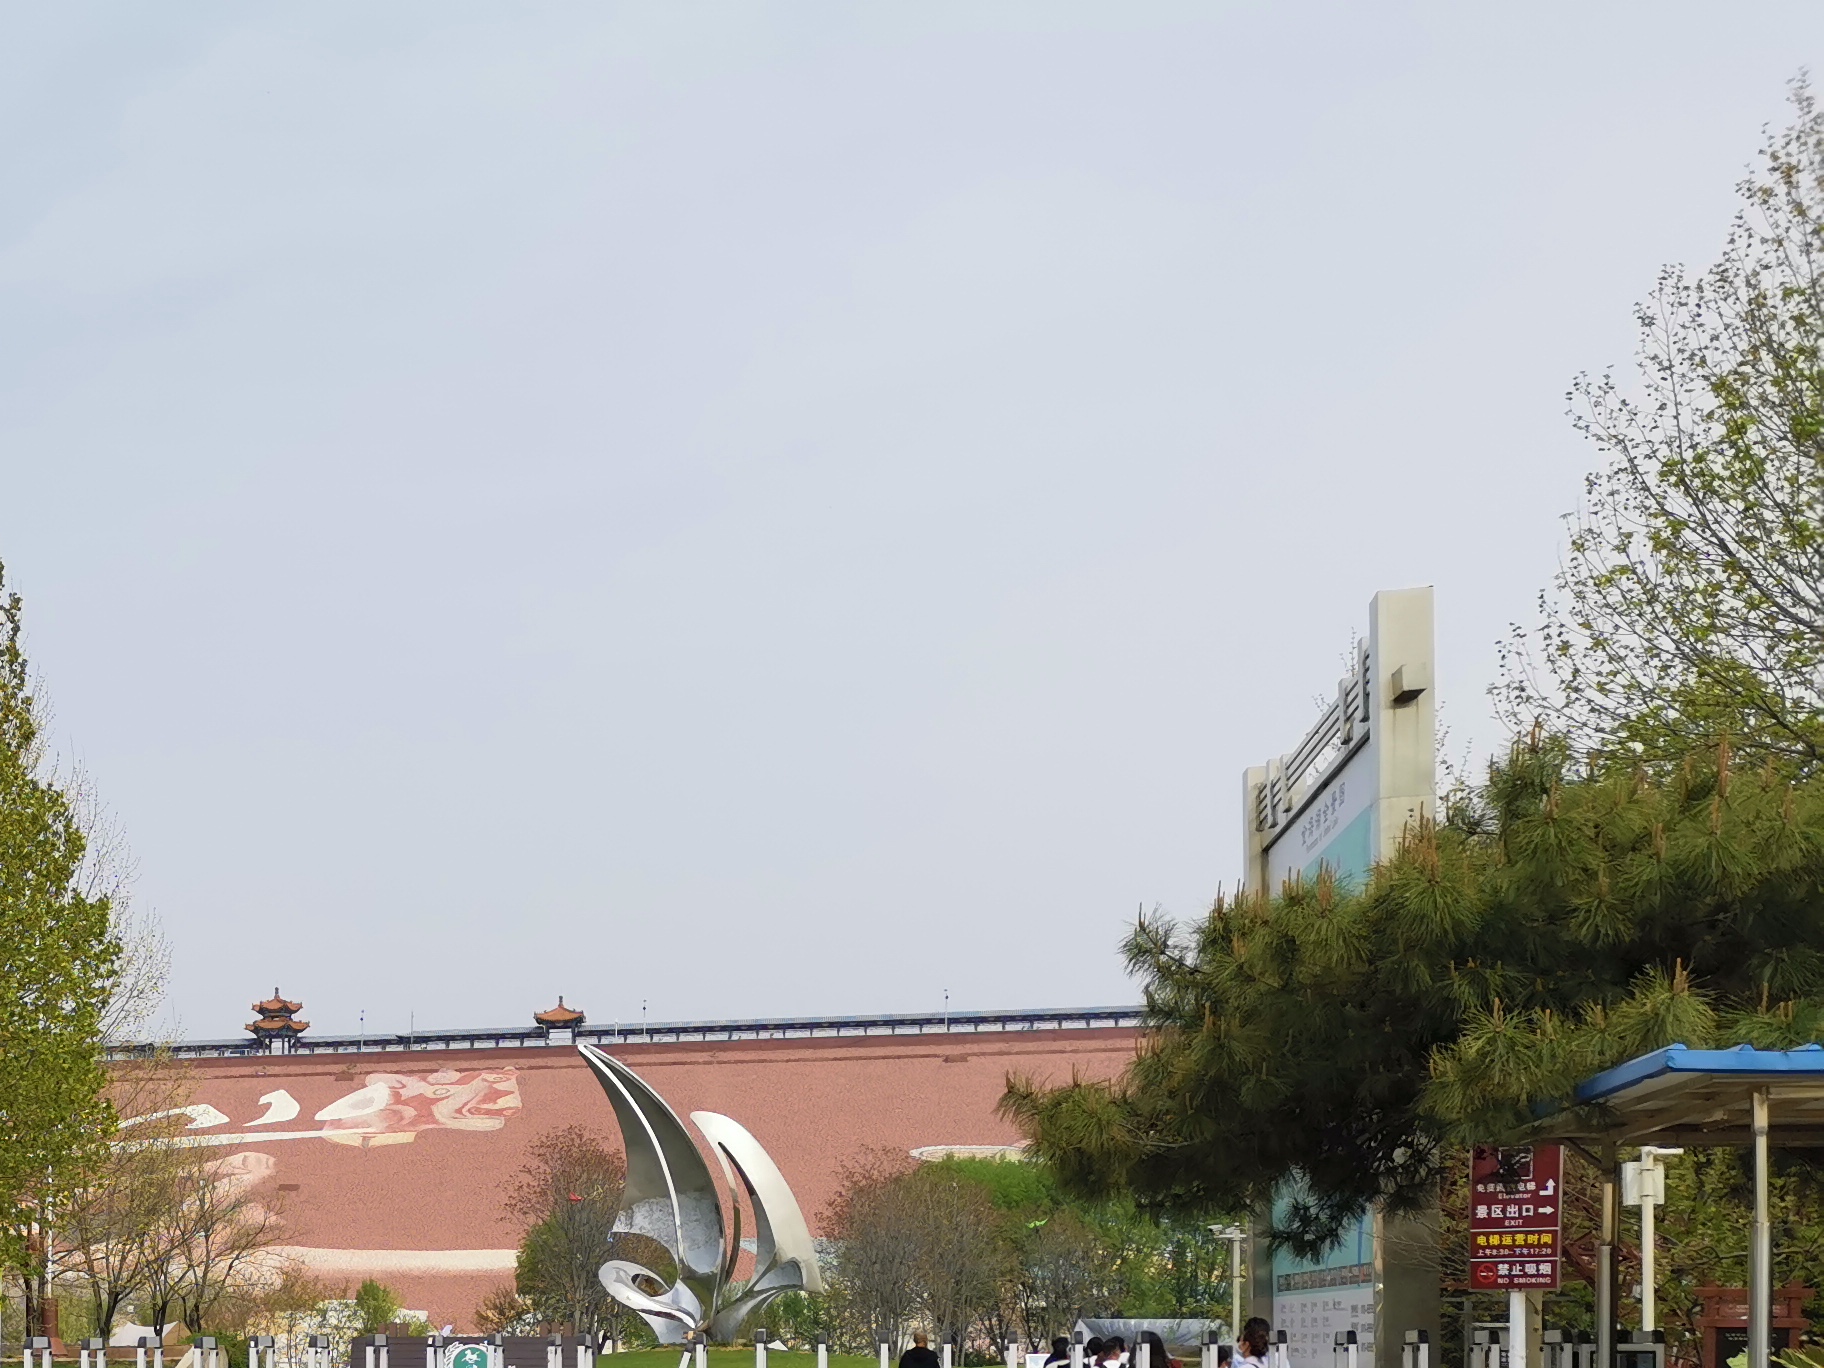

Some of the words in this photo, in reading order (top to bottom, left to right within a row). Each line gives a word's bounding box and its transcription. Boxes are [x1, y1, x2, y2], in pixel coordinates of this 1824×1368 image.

[1475, 1204, 1534, 1218] 景区出口
[1476, 1233, 1553, 1246] 电梯运营时间
[1497, 1262, 1553, 1276] 禁止吸烟
[1513, 1276, 1552, 1284] SMOKING
